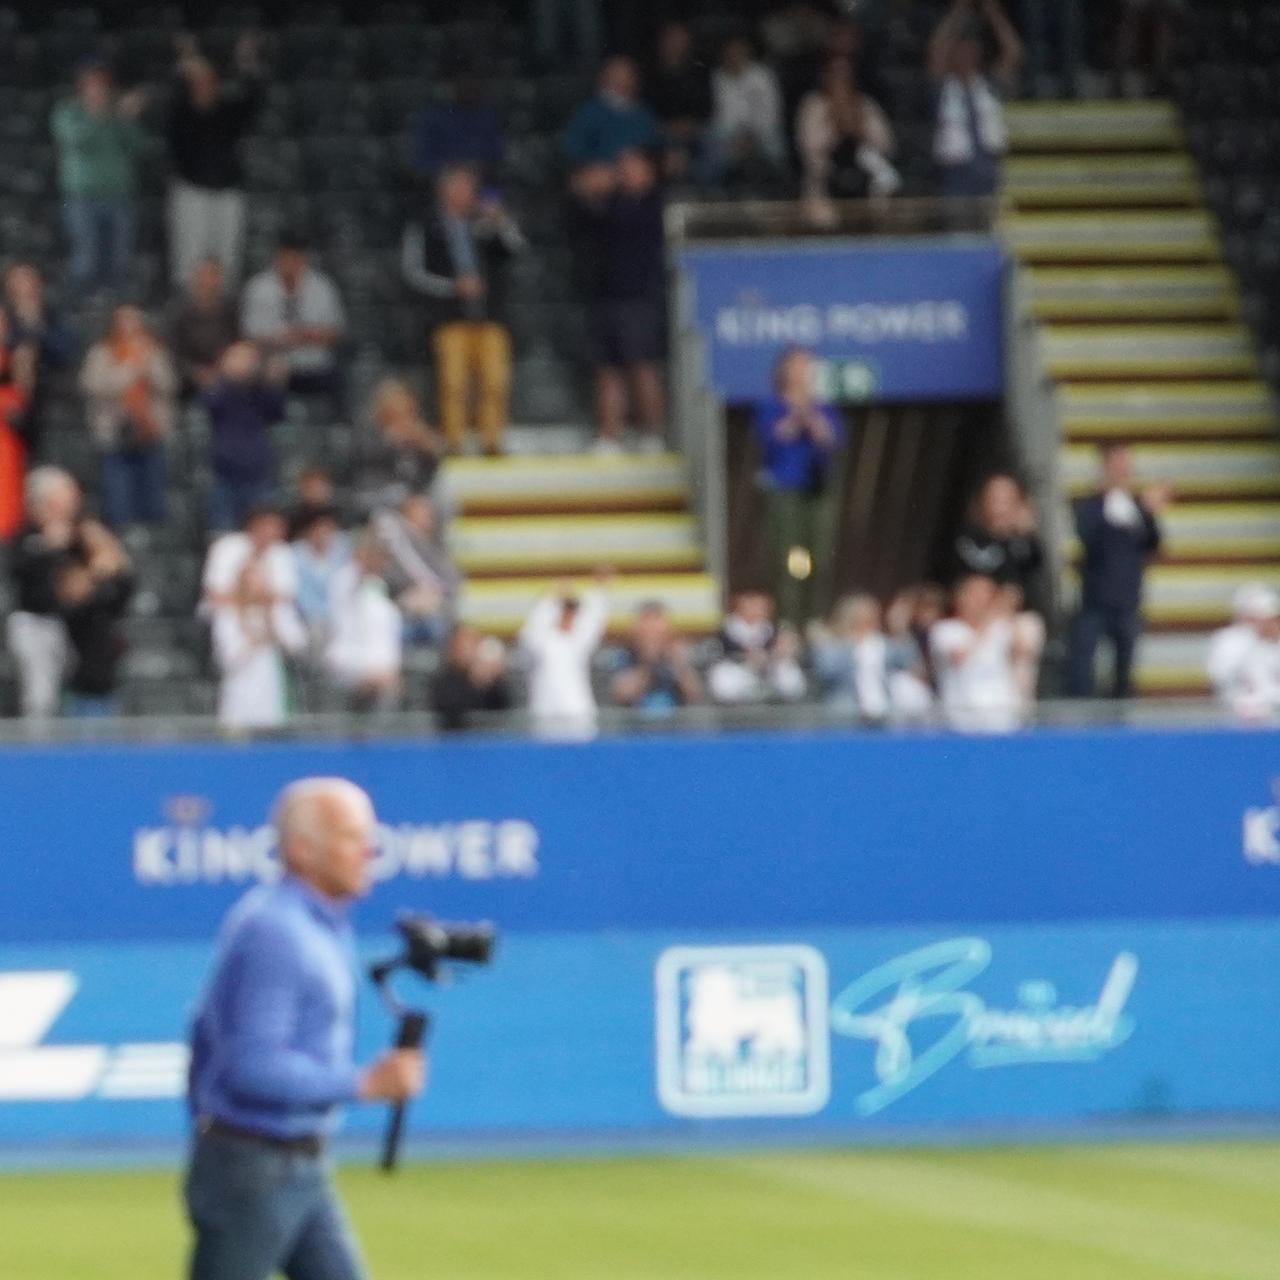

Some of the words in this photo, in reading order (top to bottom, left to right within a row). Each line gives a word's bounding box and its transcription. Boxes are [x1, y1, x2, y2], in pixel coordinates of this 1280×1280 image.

[716, 304, 820, 344] KING
[827, 301, 968, 342] POWER
[366, 819, 539, 882] OWER
